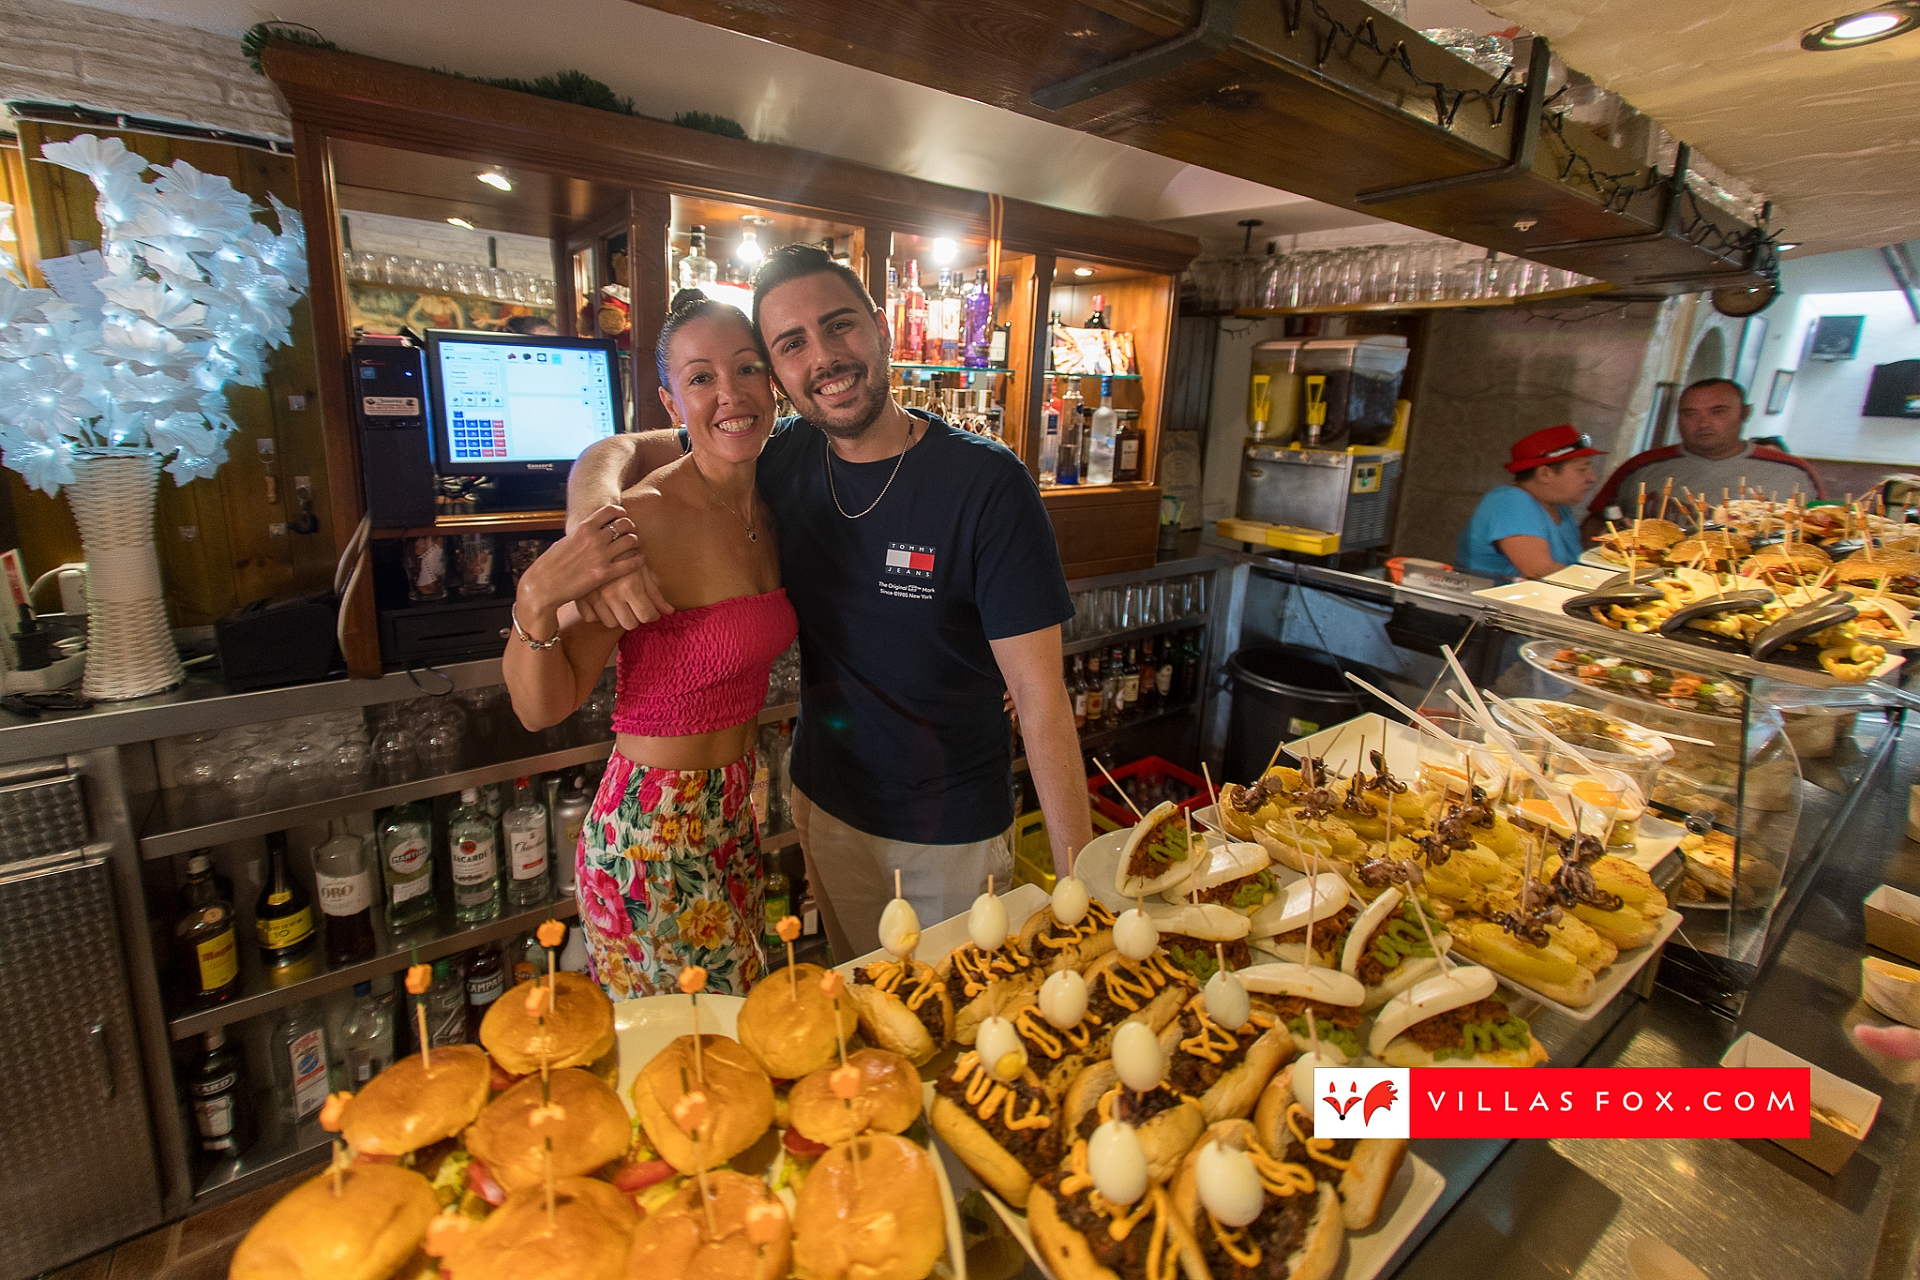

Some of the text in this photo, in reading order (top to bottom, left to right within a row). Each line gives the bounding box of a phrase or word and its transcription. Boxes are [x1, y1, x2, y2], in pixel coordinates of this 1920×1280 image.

[891, 543, 934, 553] TOMMY
[888, 566, 930, 577] JEANS
[888, 583, 907, 591] Original
[392, 847, 427, 864] MARTINI
[322, 884, 354, 898] ORO
[274, 930, 289, 938] 10
